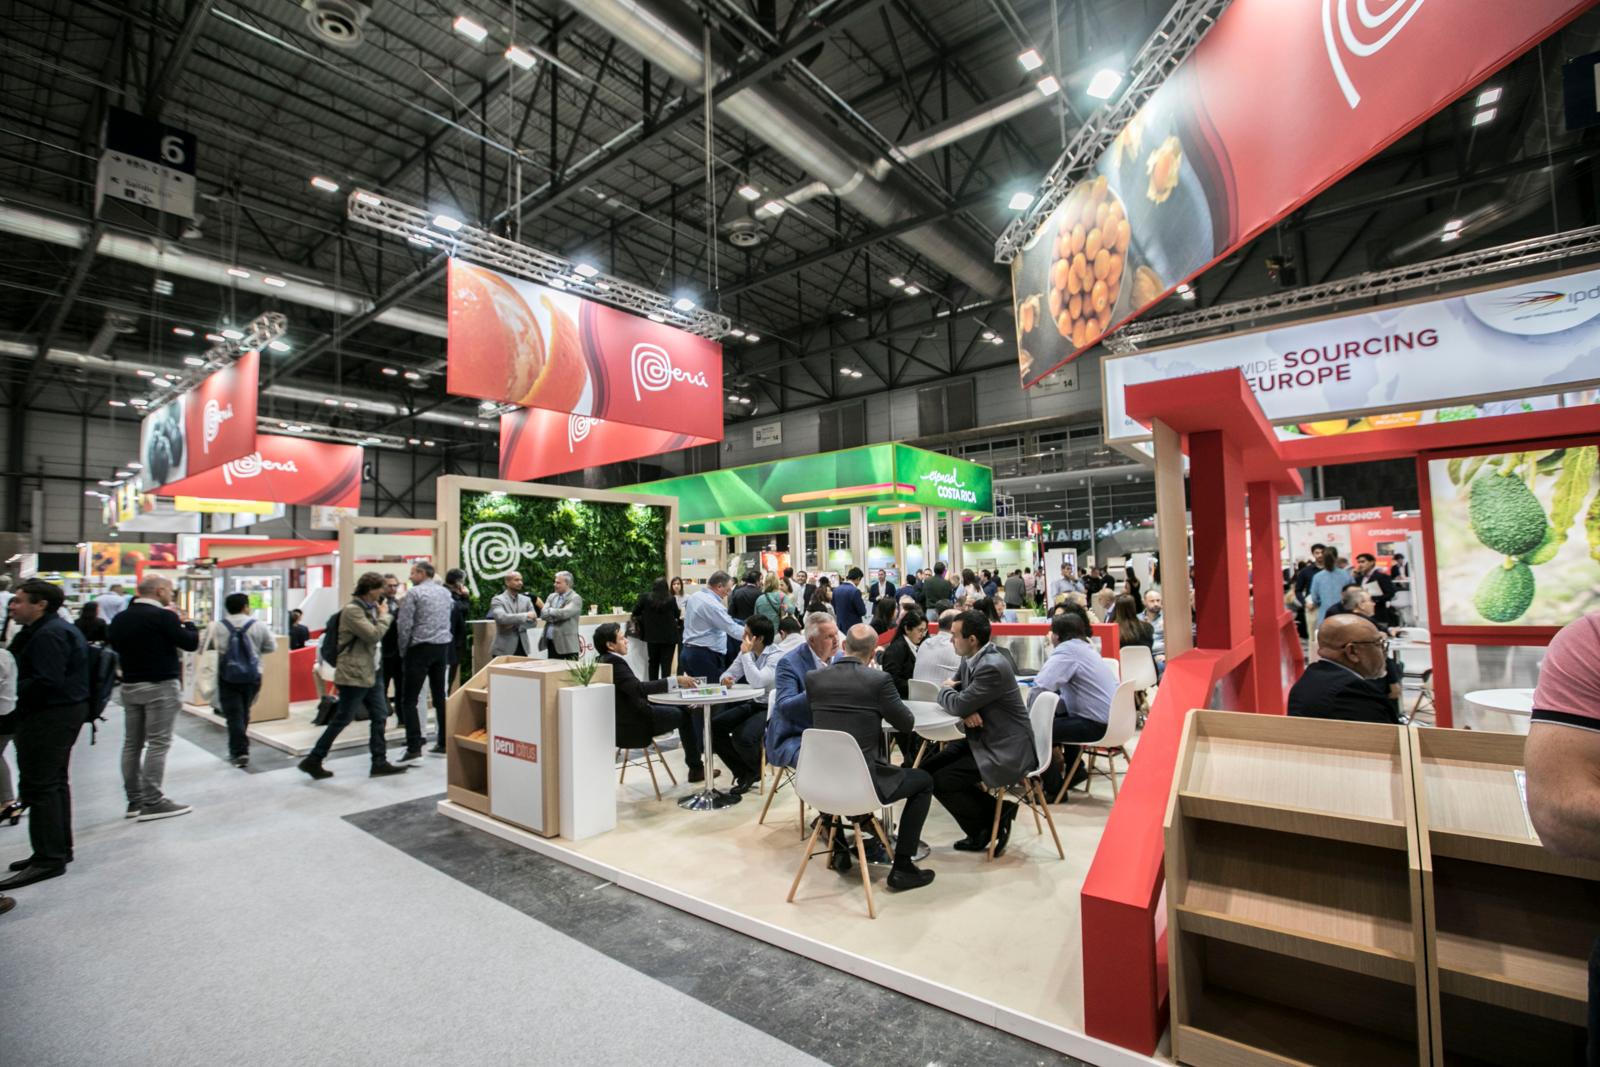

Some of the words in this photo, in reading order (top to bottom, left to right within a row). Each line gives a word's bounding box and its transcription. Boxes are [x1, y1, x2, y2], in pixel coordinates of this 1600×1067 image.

[161, 135, 185, 165] 6
[1283, 328, 1440, 368] SOURCING
[631, 342, 709, 402] Perú
[1249, 363, 1352, 394] EUROPE
[937, 485, 961, 501] COSTA
[960, 489, 977, 504] RICA
[463, 521, 573, 598] Perú
[494, 739, 515, 754] peru
